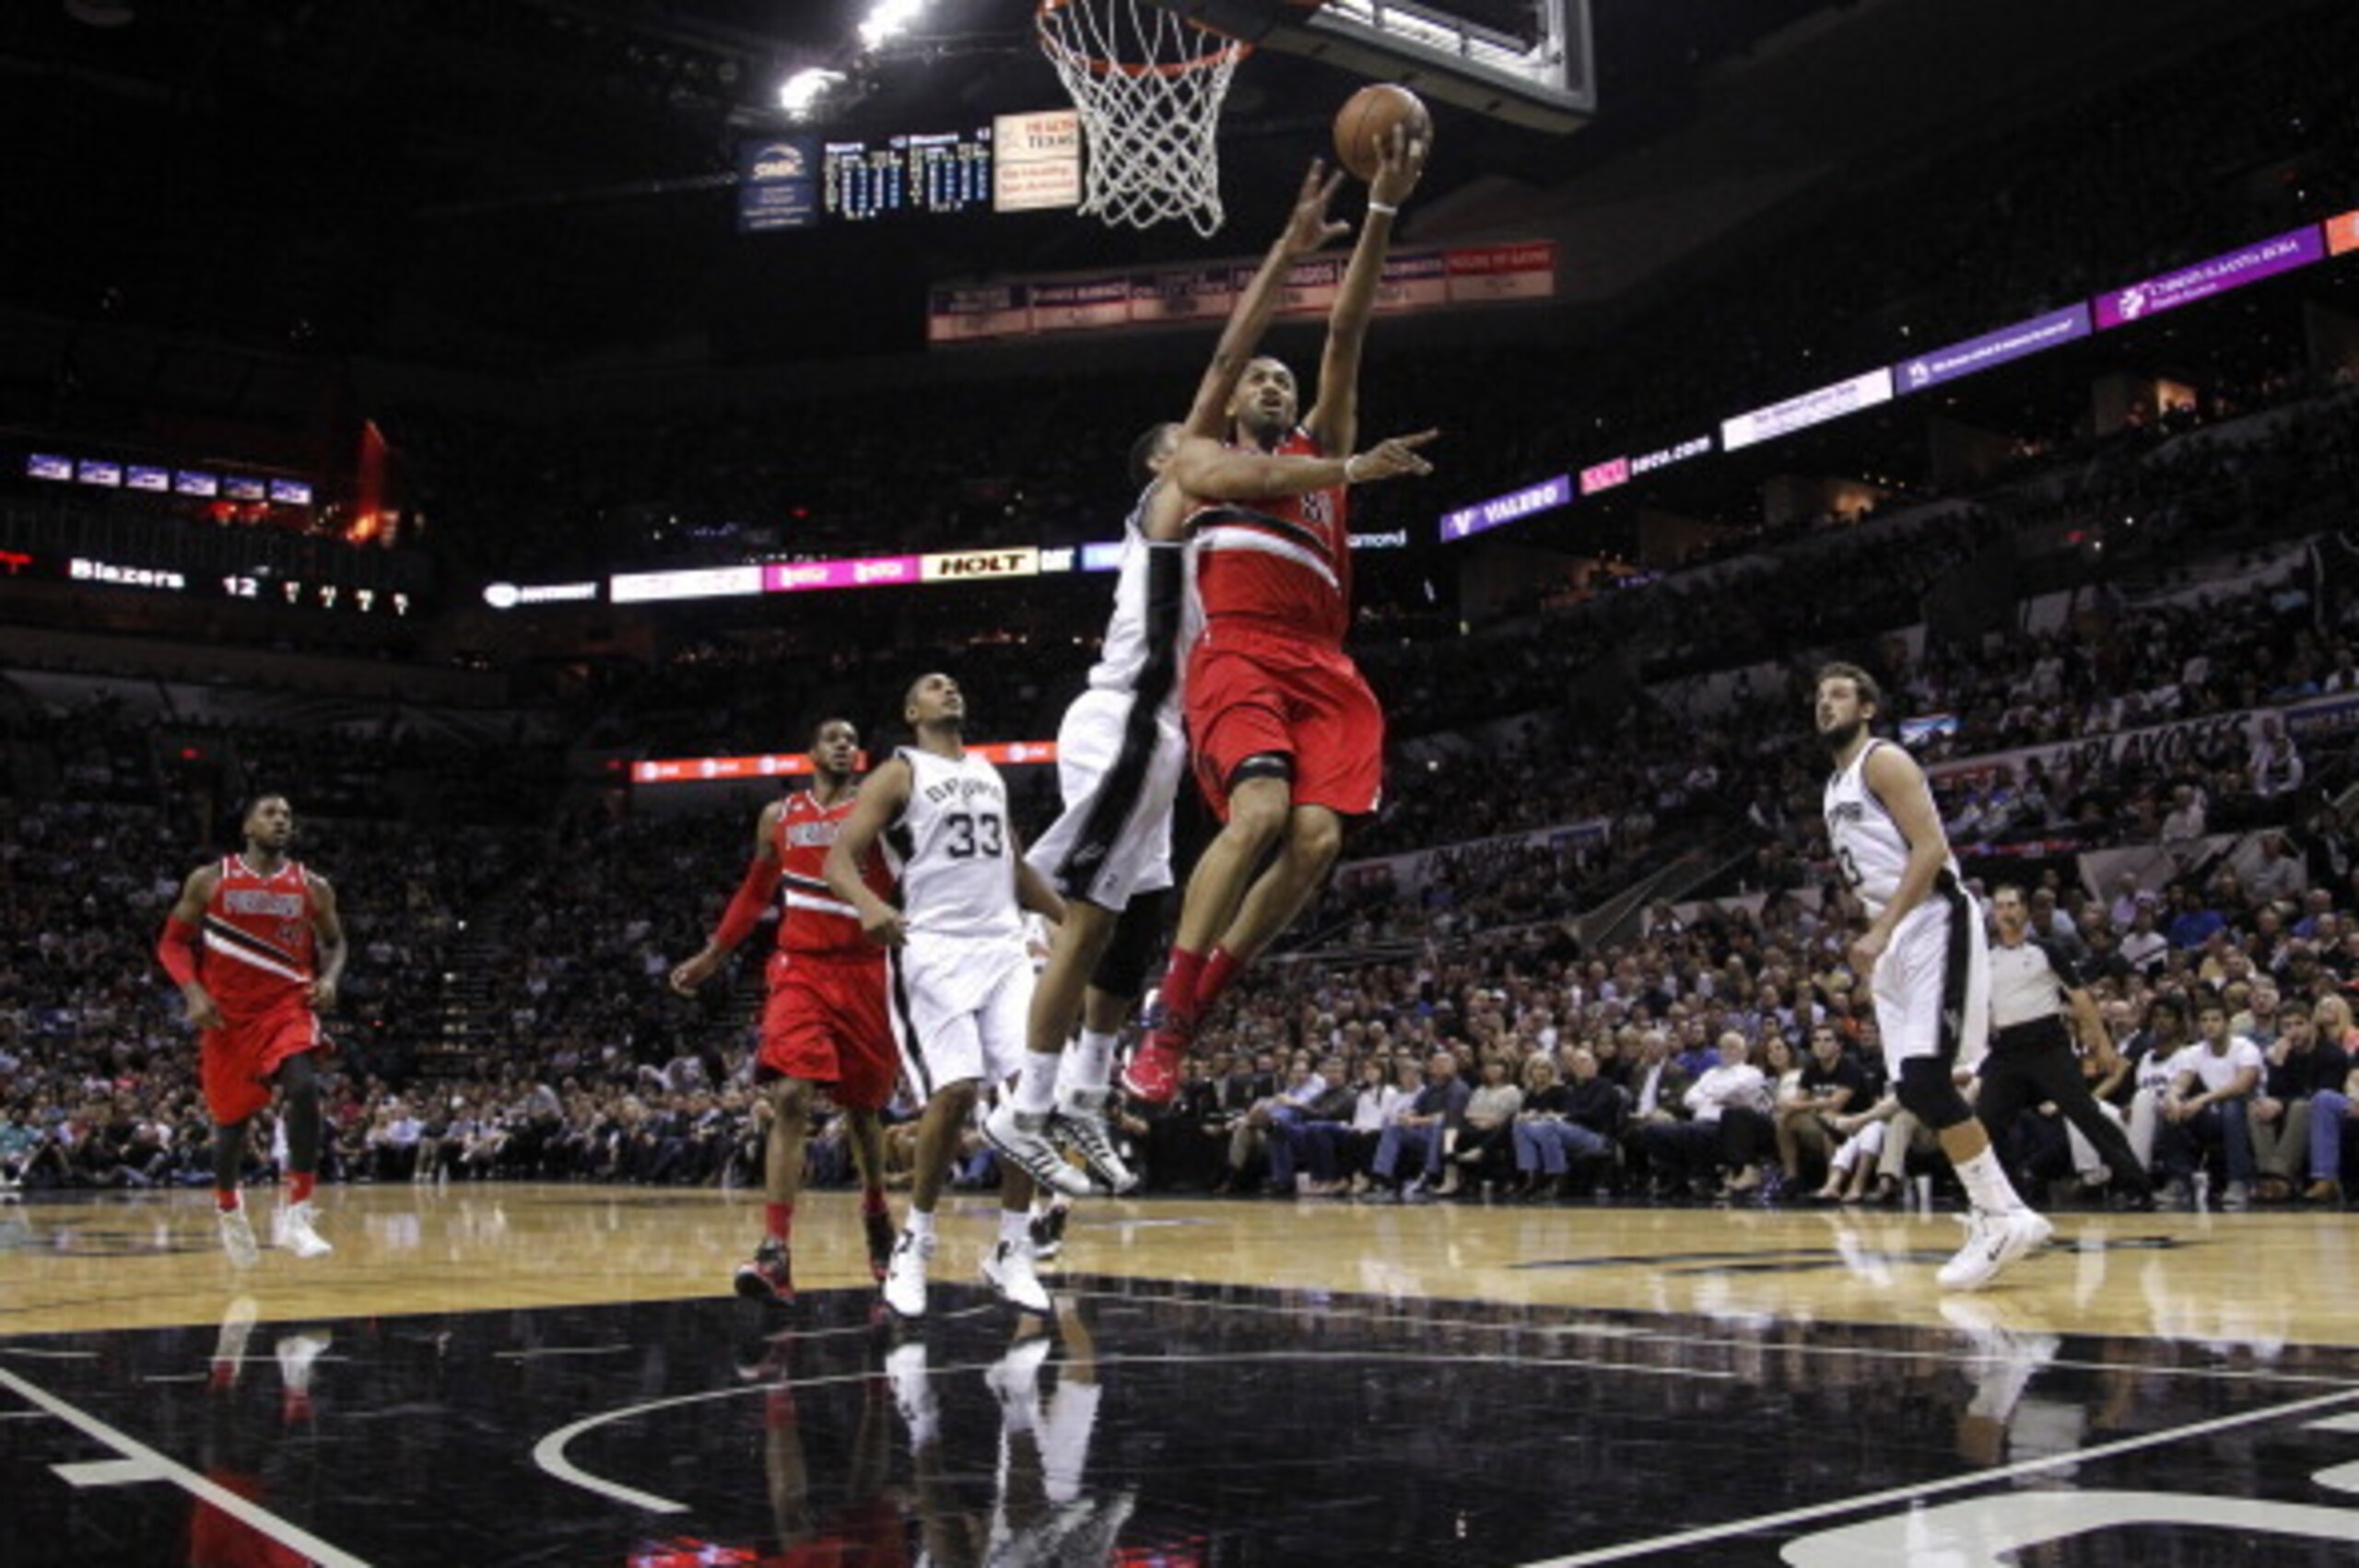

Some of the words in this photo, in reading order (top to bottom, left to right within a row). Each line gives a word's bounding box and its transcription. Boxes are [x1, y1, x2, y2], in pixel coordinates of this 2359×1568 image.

[1483, 484, 1559, 523] VALERO
[1346, 528, 1407, 548] amond
[70, 557, 185, 589] Blazers
[222, 576, 259, 597] 12
[939, 554, 1026, 576] HOLT
[945, 813, 1003, 859] 33
